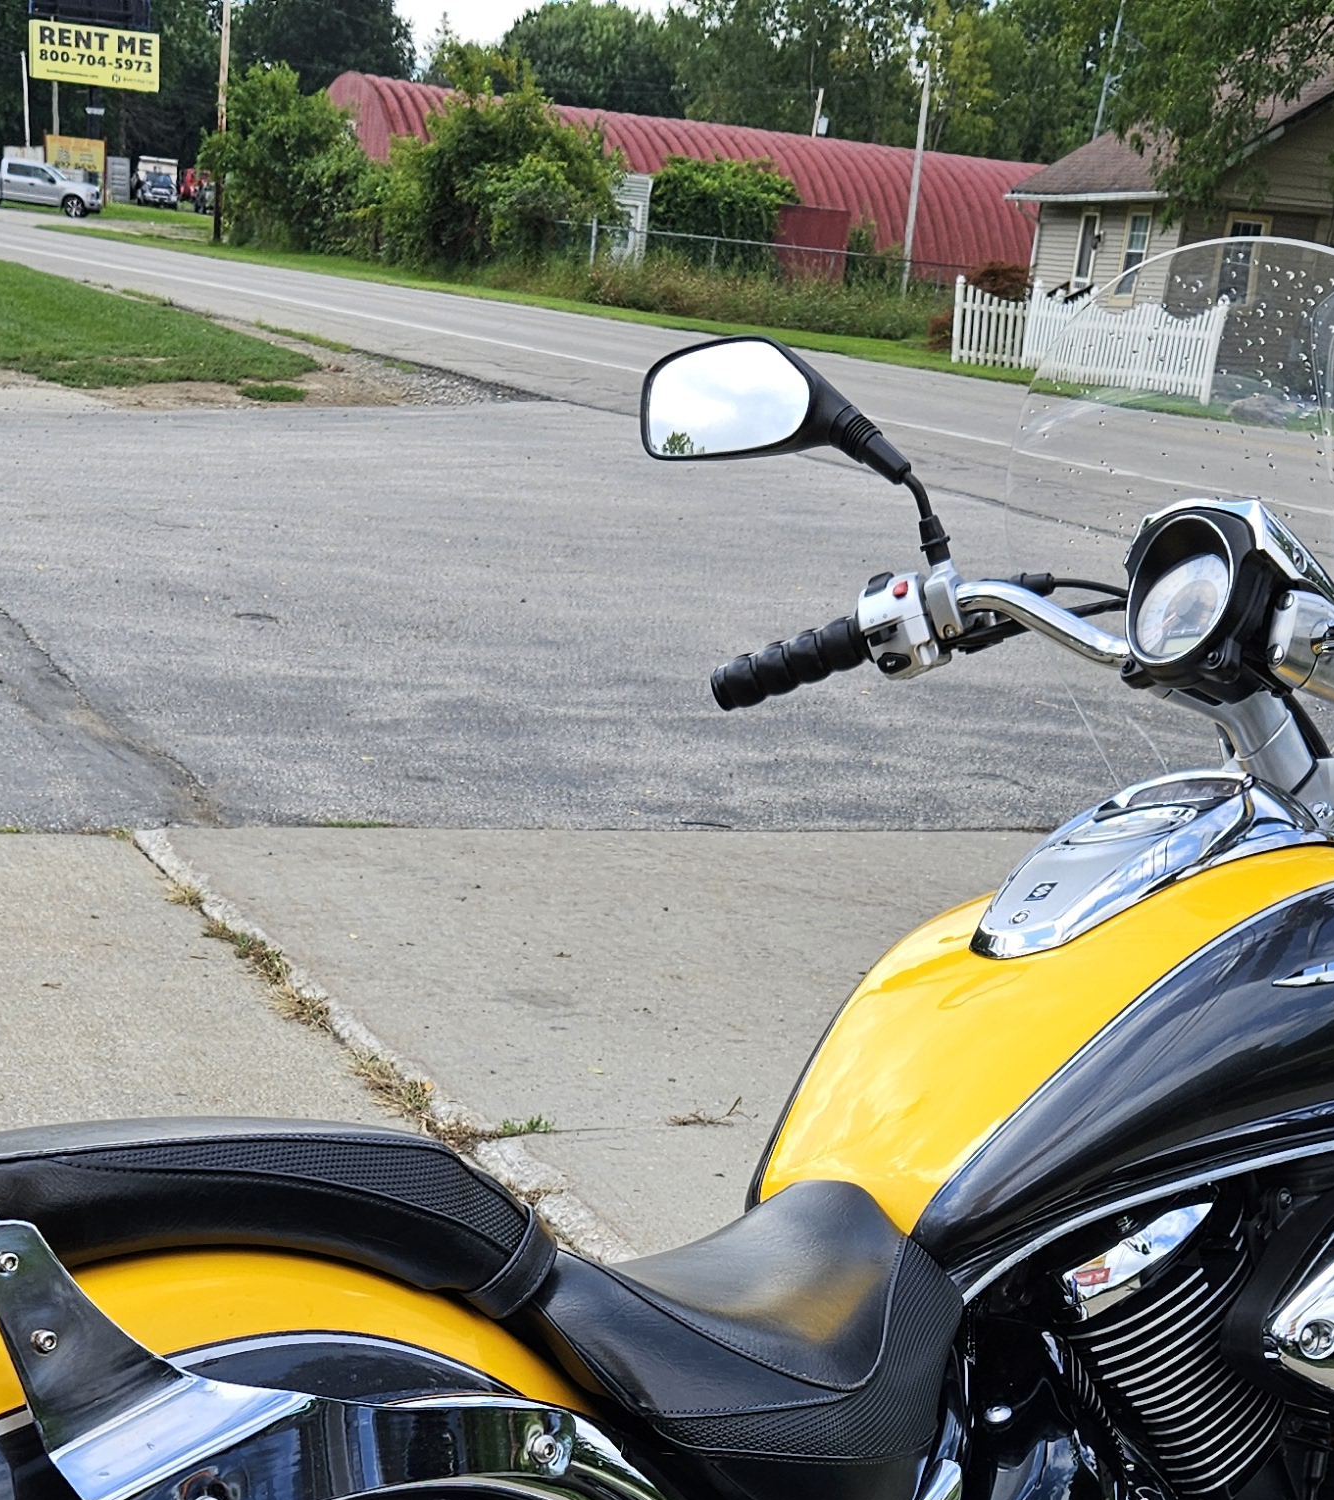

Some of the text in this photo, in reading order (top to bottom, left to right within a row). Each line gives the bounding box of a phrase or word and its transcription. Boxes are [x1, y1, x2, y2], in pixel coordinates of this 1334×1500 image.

[39, 25, 153, 57] RENT ME
[39, 48, 153, 74] 800-704-5973
